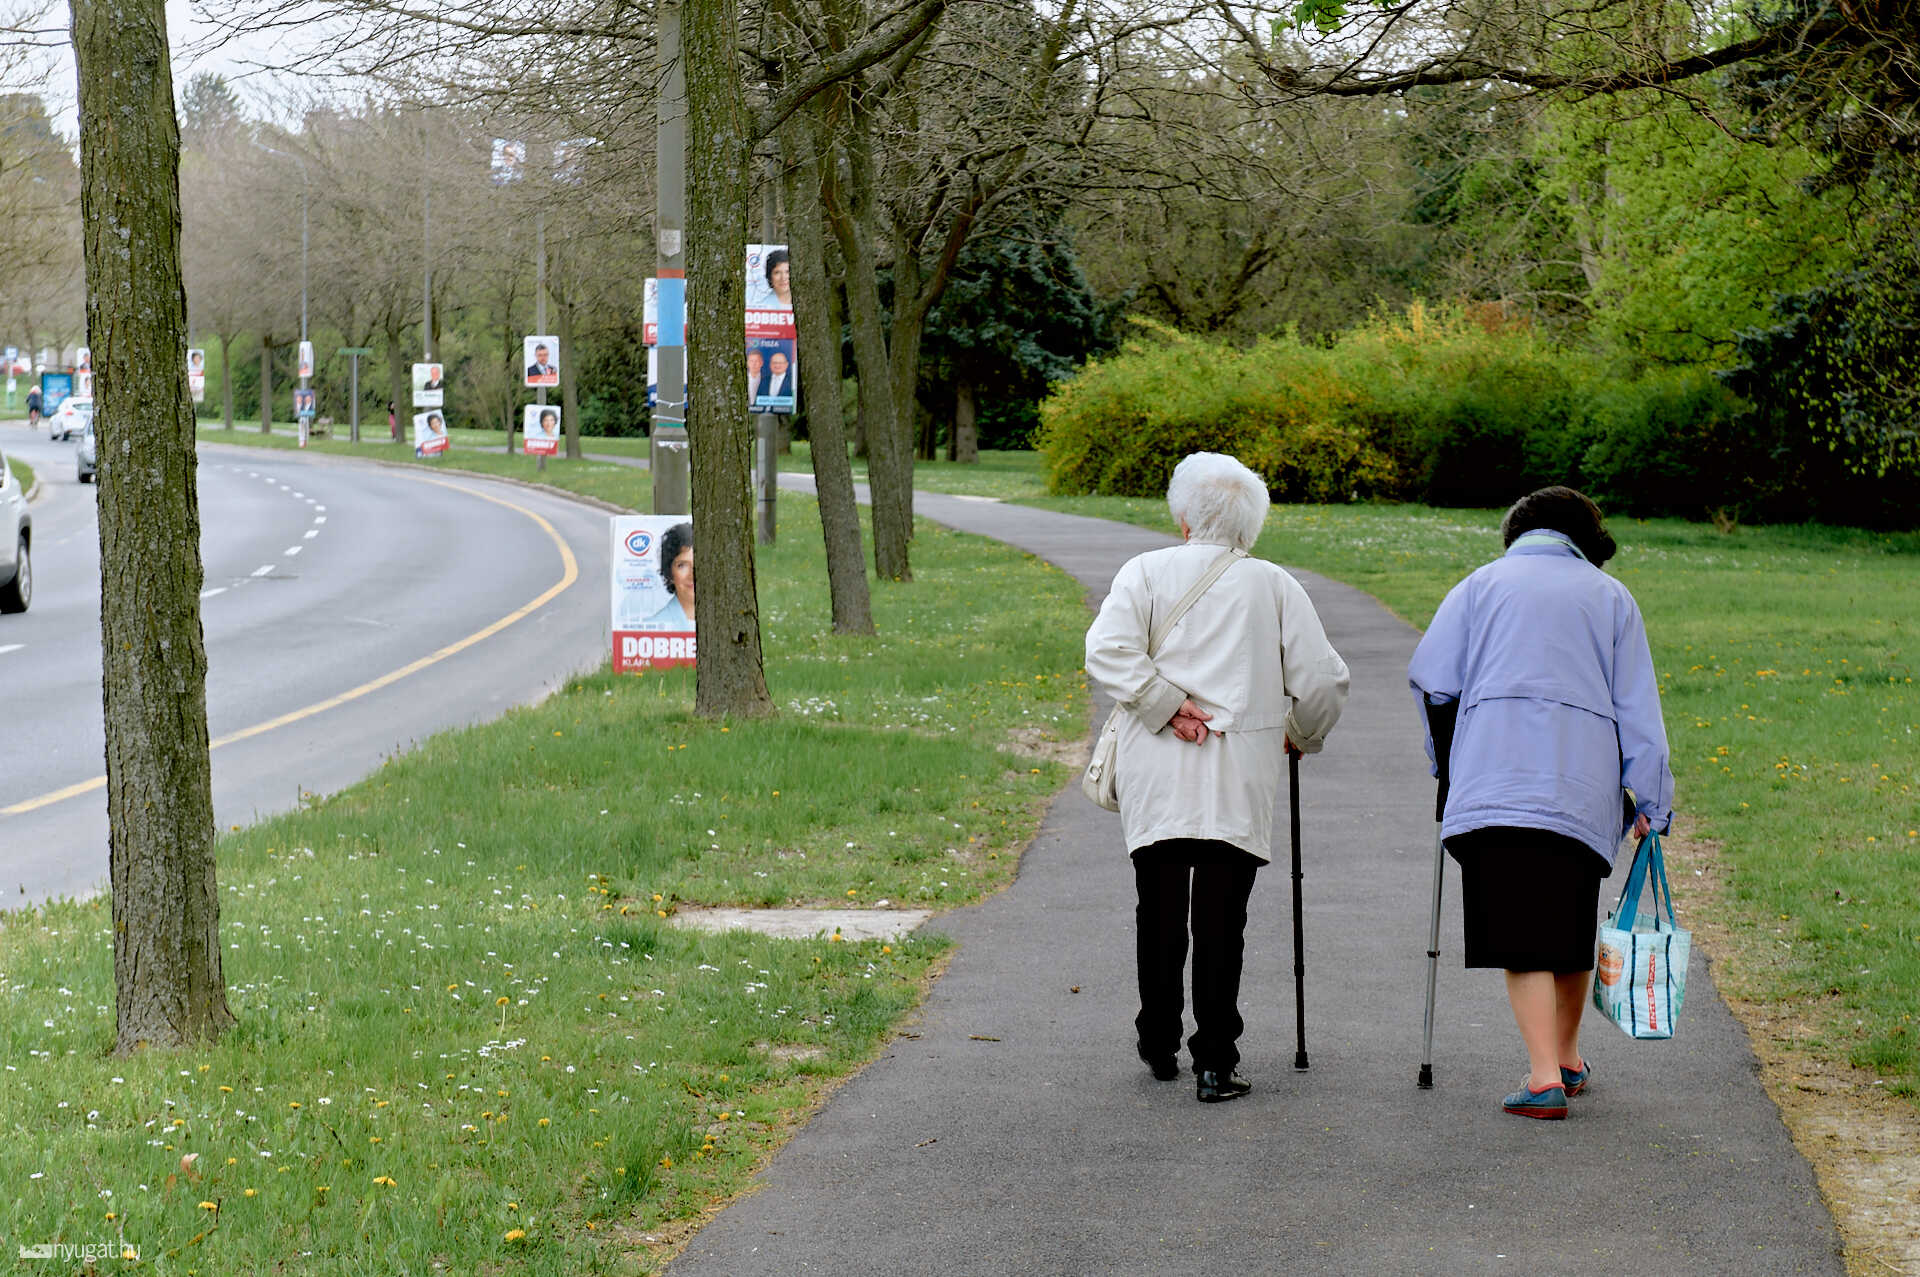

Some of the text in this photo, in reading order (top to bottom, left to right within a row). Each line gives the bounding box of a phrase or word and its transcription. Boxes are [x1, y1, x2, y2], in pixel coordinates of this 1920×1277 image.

[745, 312, 795, 325] DOBREV
[632, 535, 646, 548] dk
[622, 637, 696, 658] DOBRE
